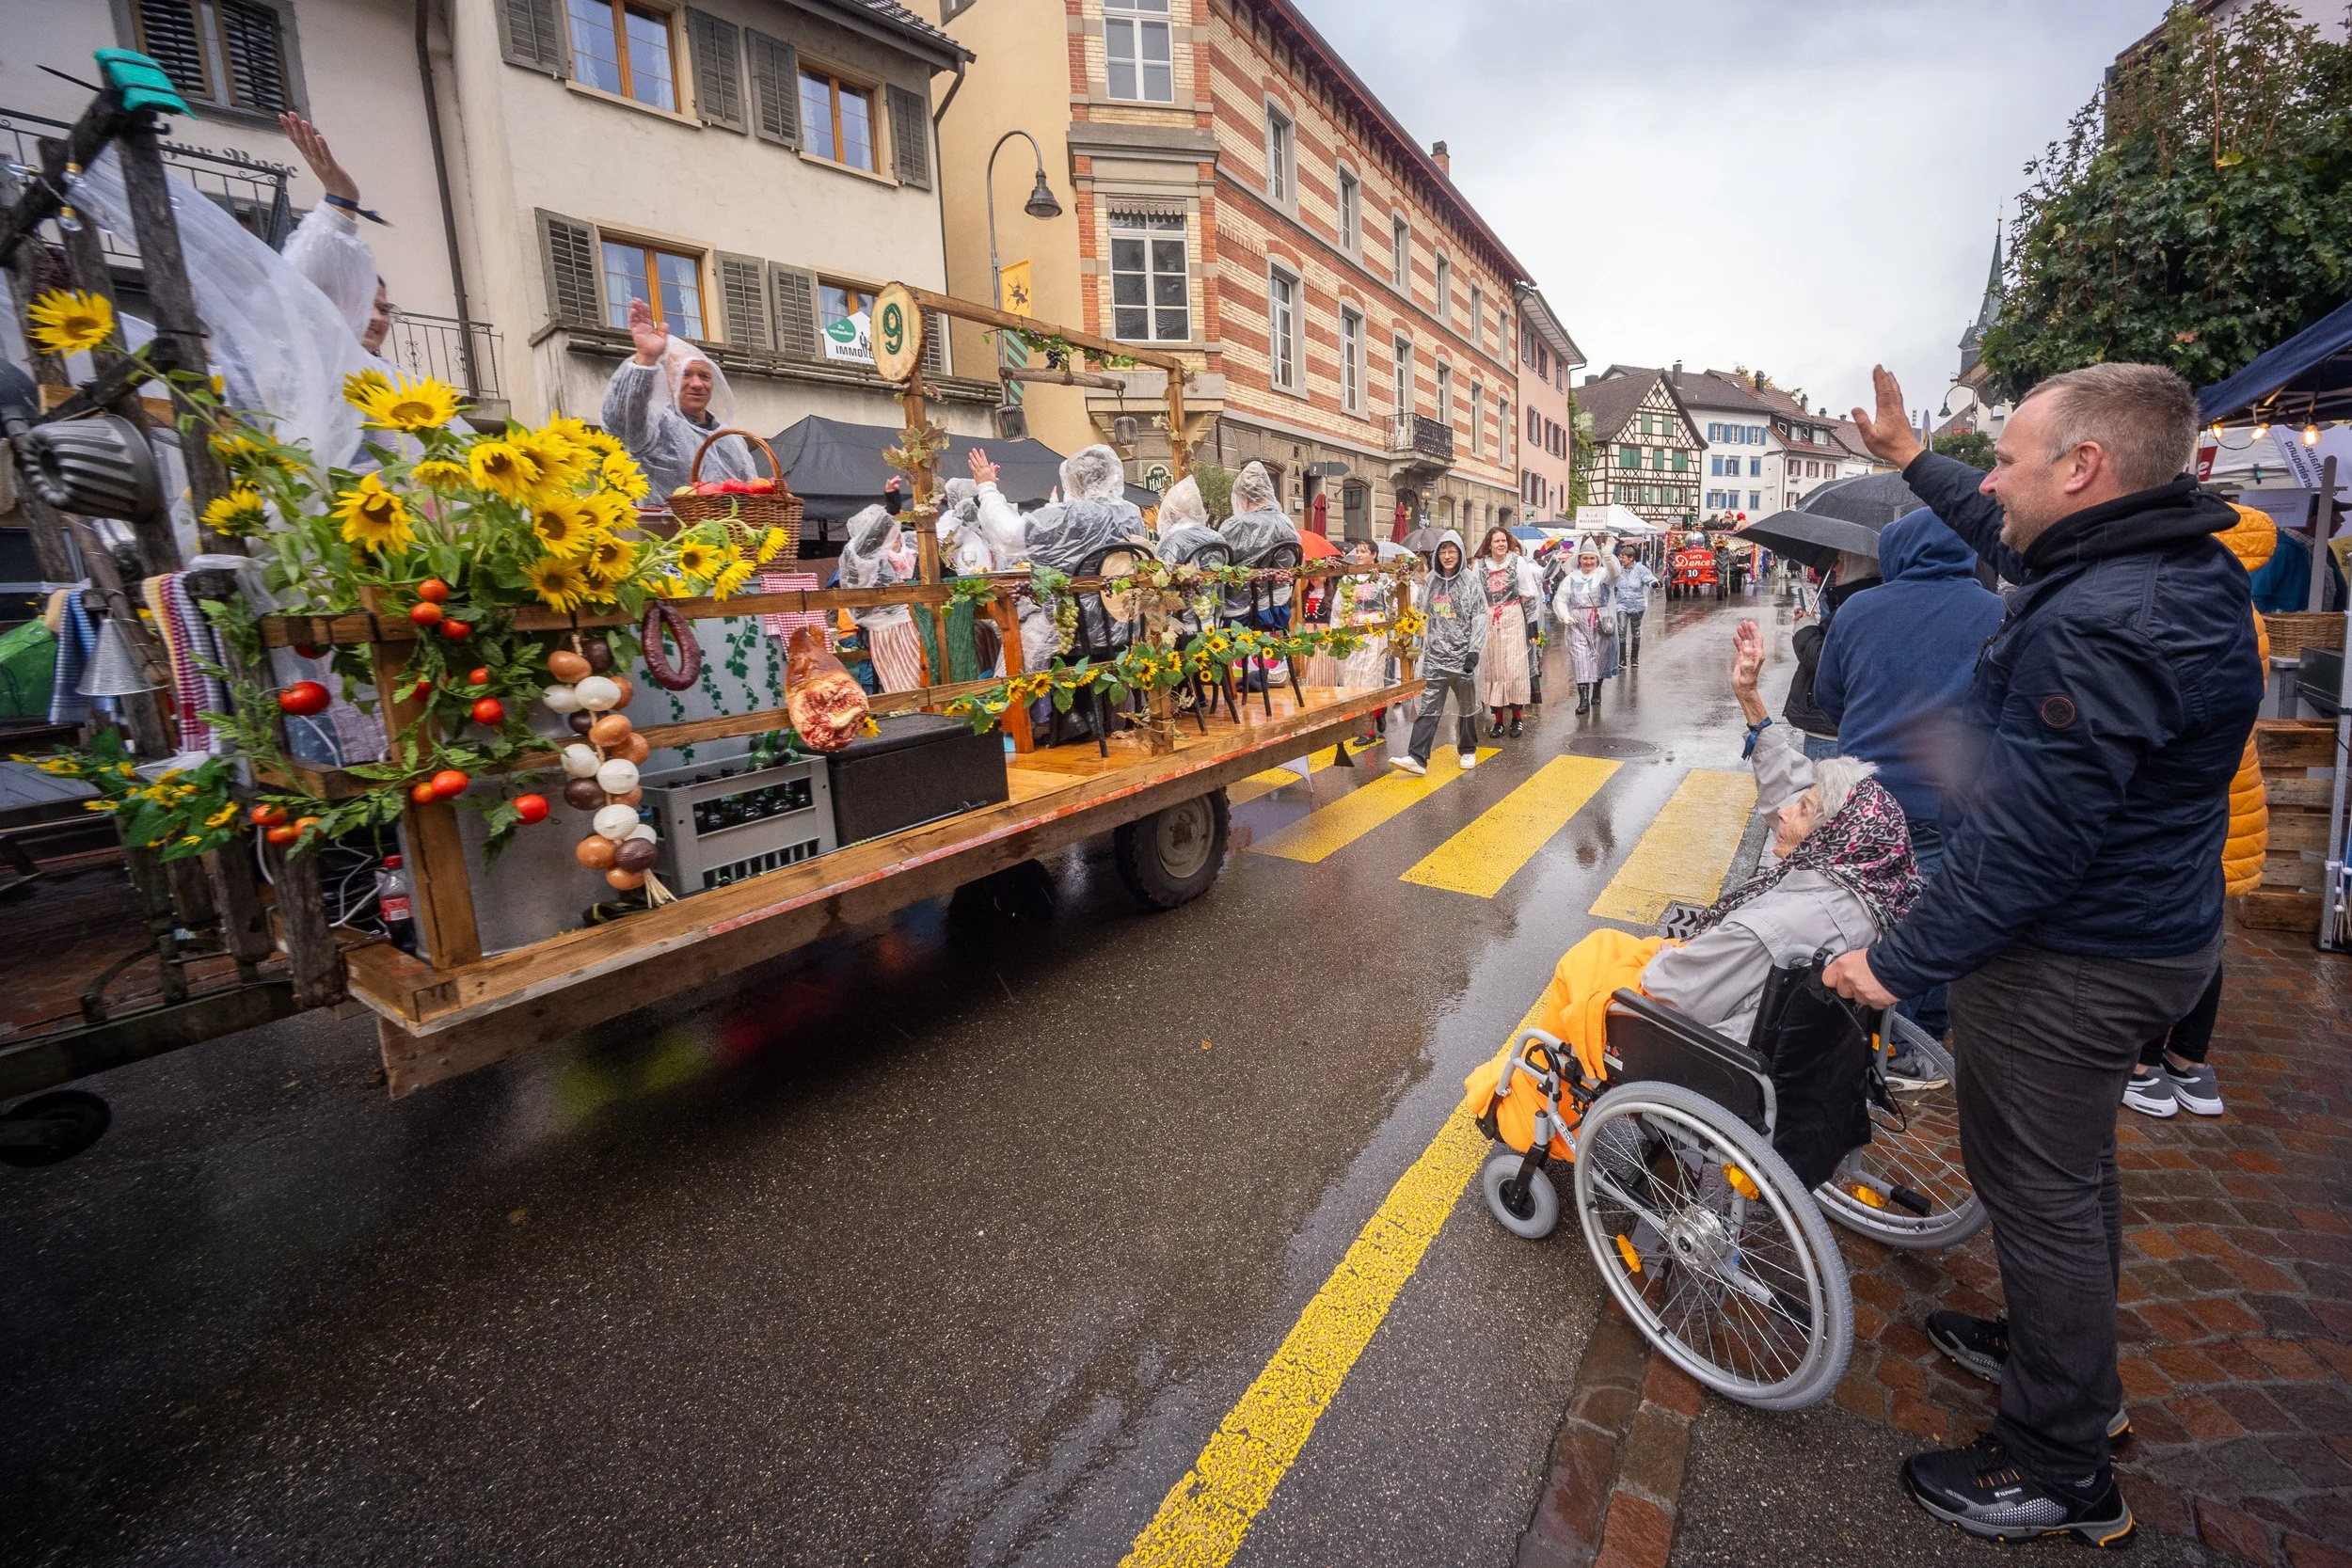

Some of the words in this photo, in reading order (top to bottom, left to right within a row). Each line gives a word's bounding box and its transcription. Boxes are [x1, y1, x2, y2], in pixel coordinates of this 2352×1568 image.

[883, 303, 903, 355] 9
[1675, 555, 1710, 567] Dance
[1688, 569, 1698, 578] 10
